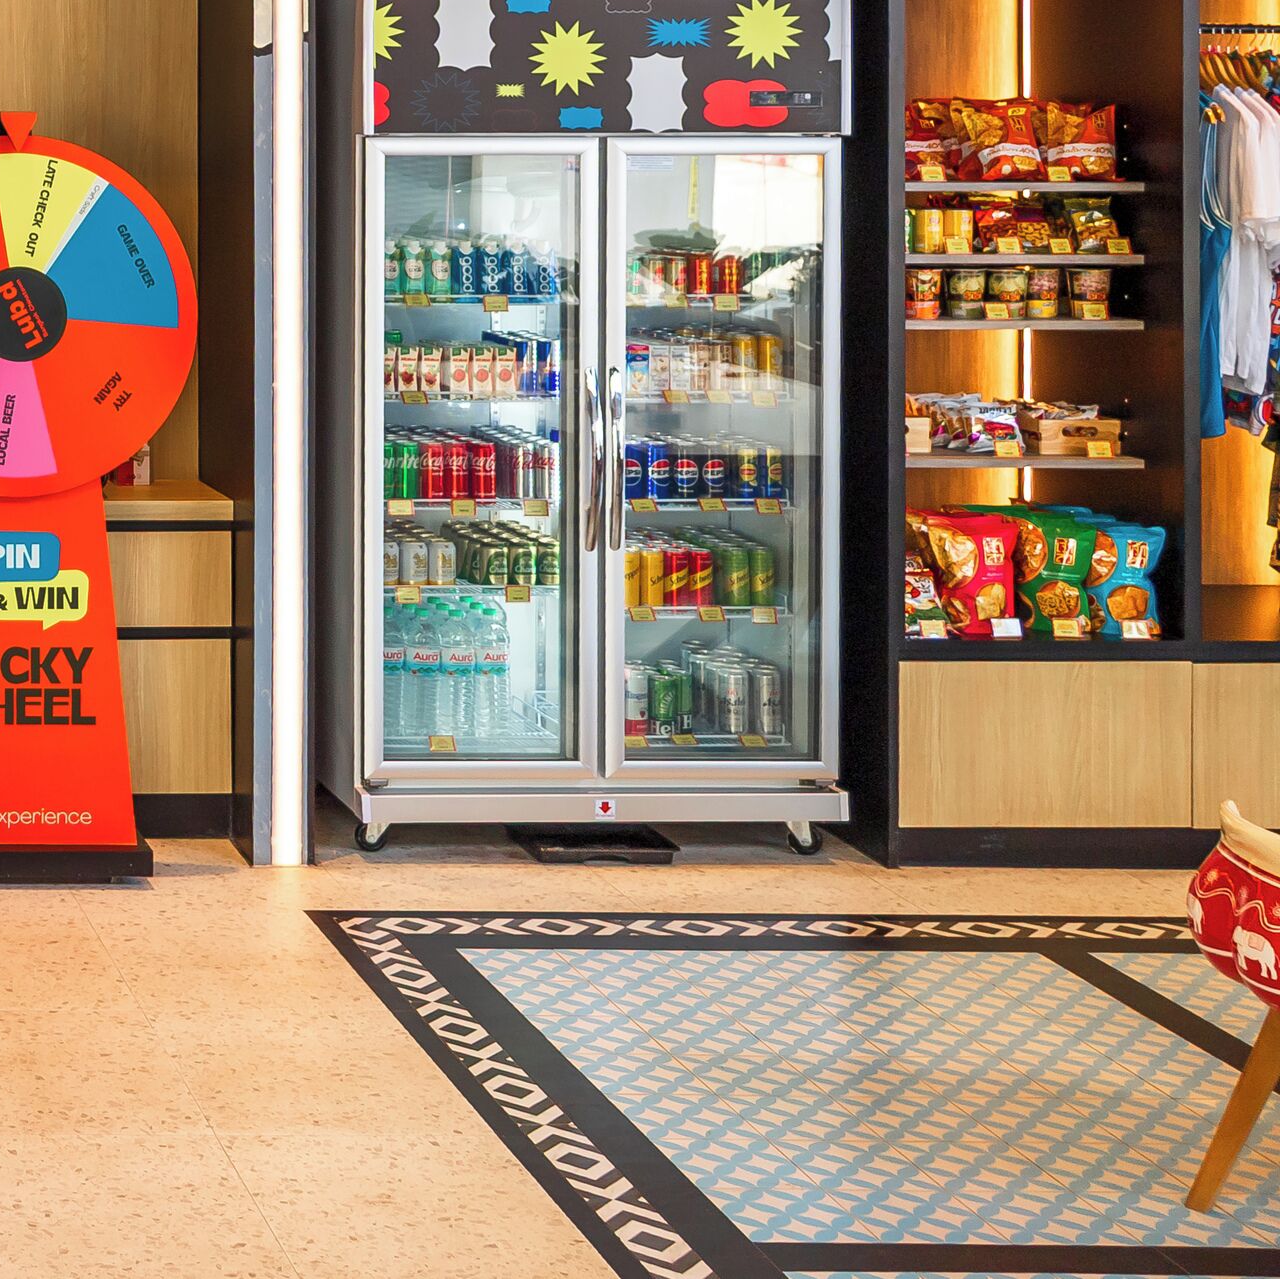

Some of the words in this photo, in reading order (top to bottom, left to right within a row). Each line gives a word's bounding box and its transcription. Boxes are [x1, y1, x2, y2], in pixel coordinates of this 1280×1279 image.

[43, 159, 59, 188] LATE
[32, 189, 50, 228] CHECK
[25, 232, 39, 258] OUT
[116, 224, 139, 258] GAME
[135, 257, 155, 288] OVER
[10, 301, 43, 350] Lub
[93, 371, 123, 405] AGAIN
[113, 390, 132, 411] TRY
[2, 394, 16, 425] BEER
[14, 586, 79, 610] WIN
